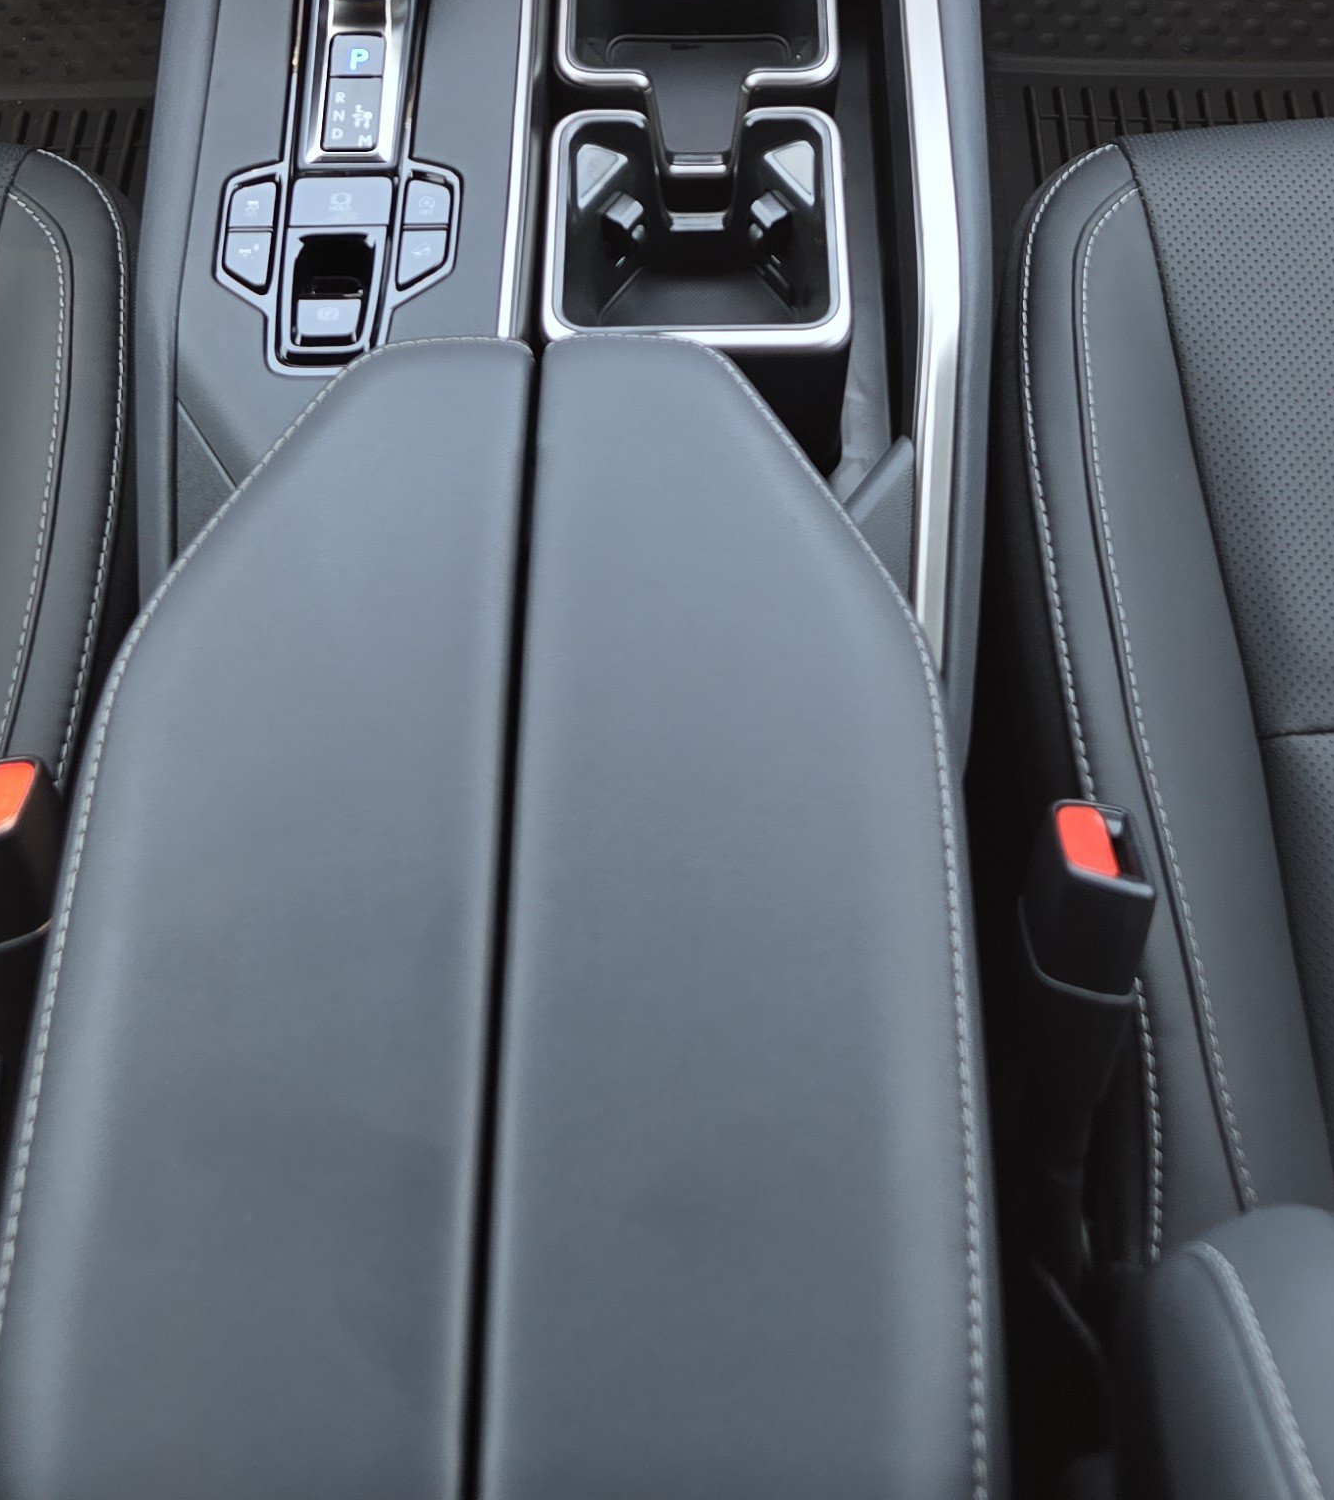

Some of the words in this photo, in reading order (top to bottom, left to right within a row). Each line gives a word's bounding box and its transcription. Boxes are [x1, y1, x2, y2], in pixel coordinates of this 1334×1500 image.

[349, 48, 369, 71] P
[335, 91, 346, 104] R
[332, 109, 346, 122] N
[331, 127, 344, 140] D
[357, 134, 373, 148] M
